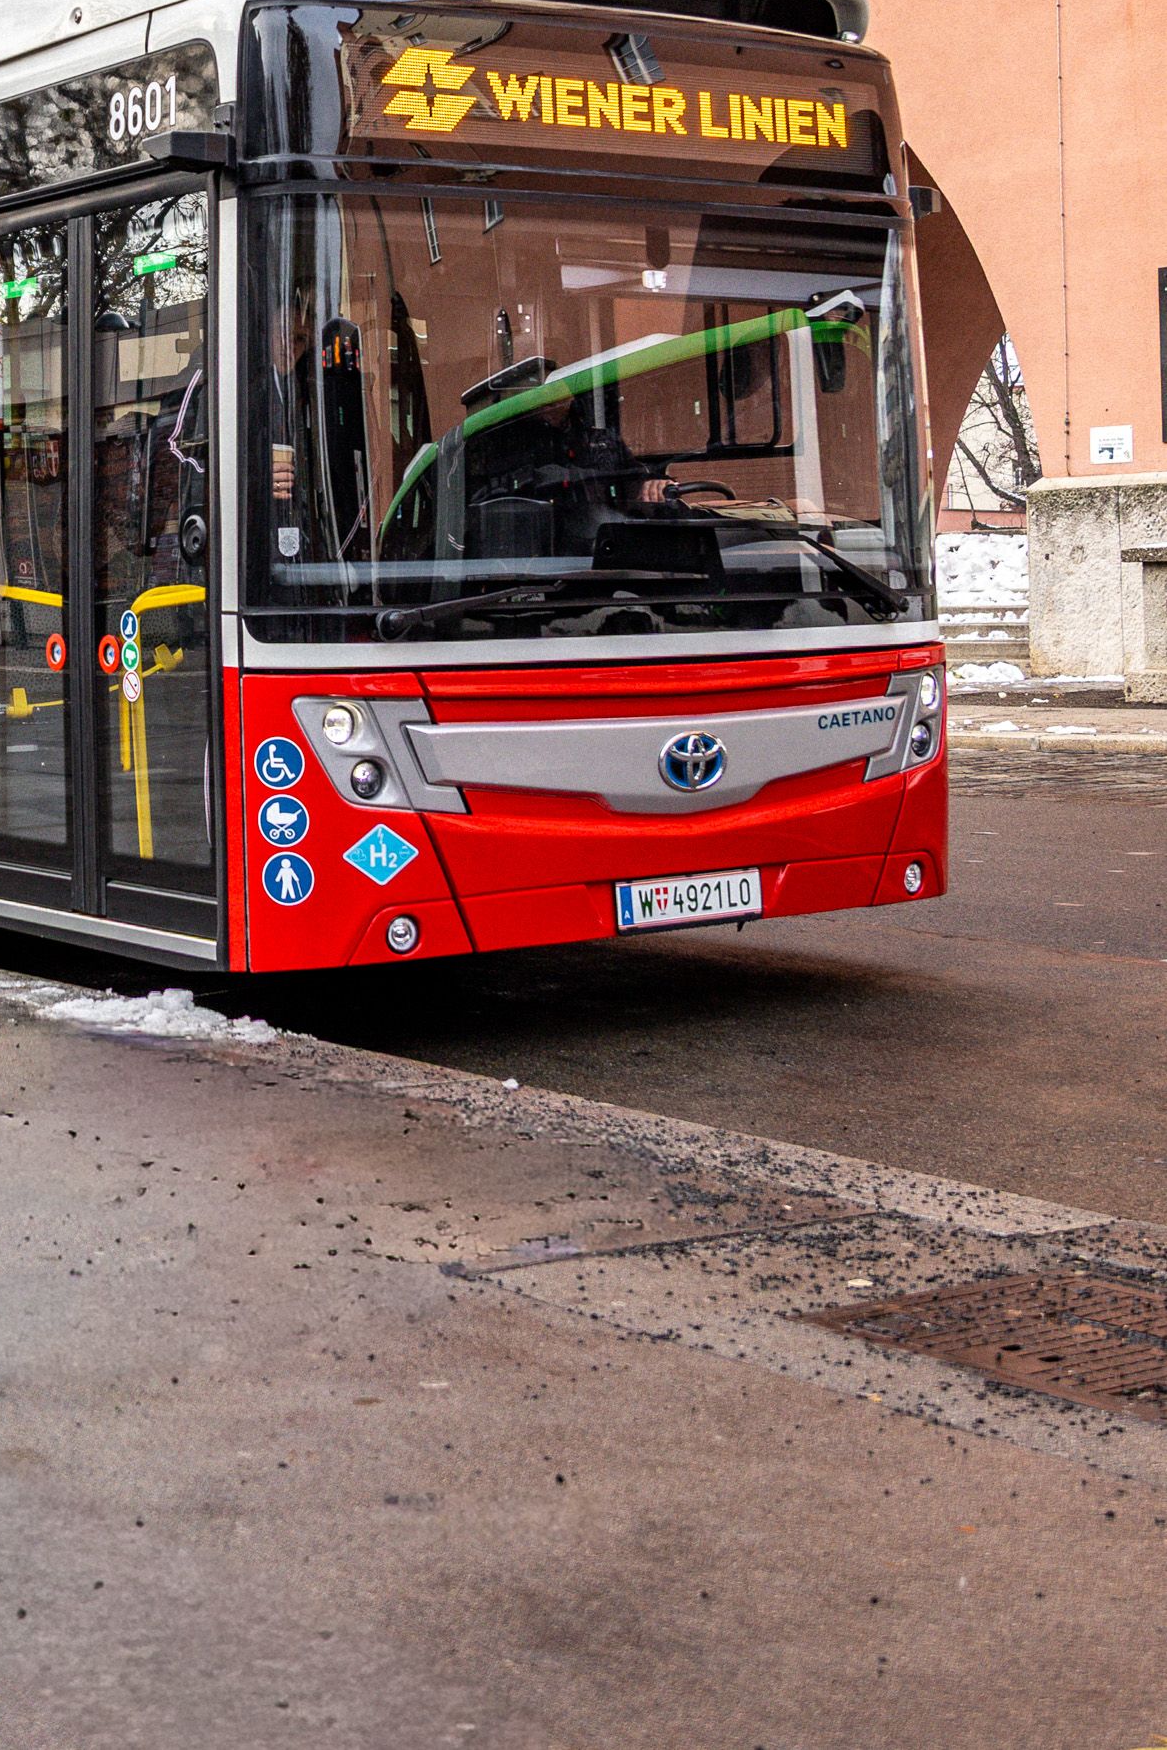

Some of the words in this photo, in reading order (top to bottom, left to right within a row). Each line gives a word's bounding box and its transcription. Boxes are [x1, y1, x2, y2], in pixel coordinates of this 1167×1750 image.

[109, 75, 177, 141] 8601
[487, 72, 688, 136] WIENER
[699, 91, 848, 149] LINIEN
[818, 706, 895, 729] CAETANO
[369, 844, 398, 869] H2
[624, 910, 631, 919] A
[638, 888, 654, 919] W
